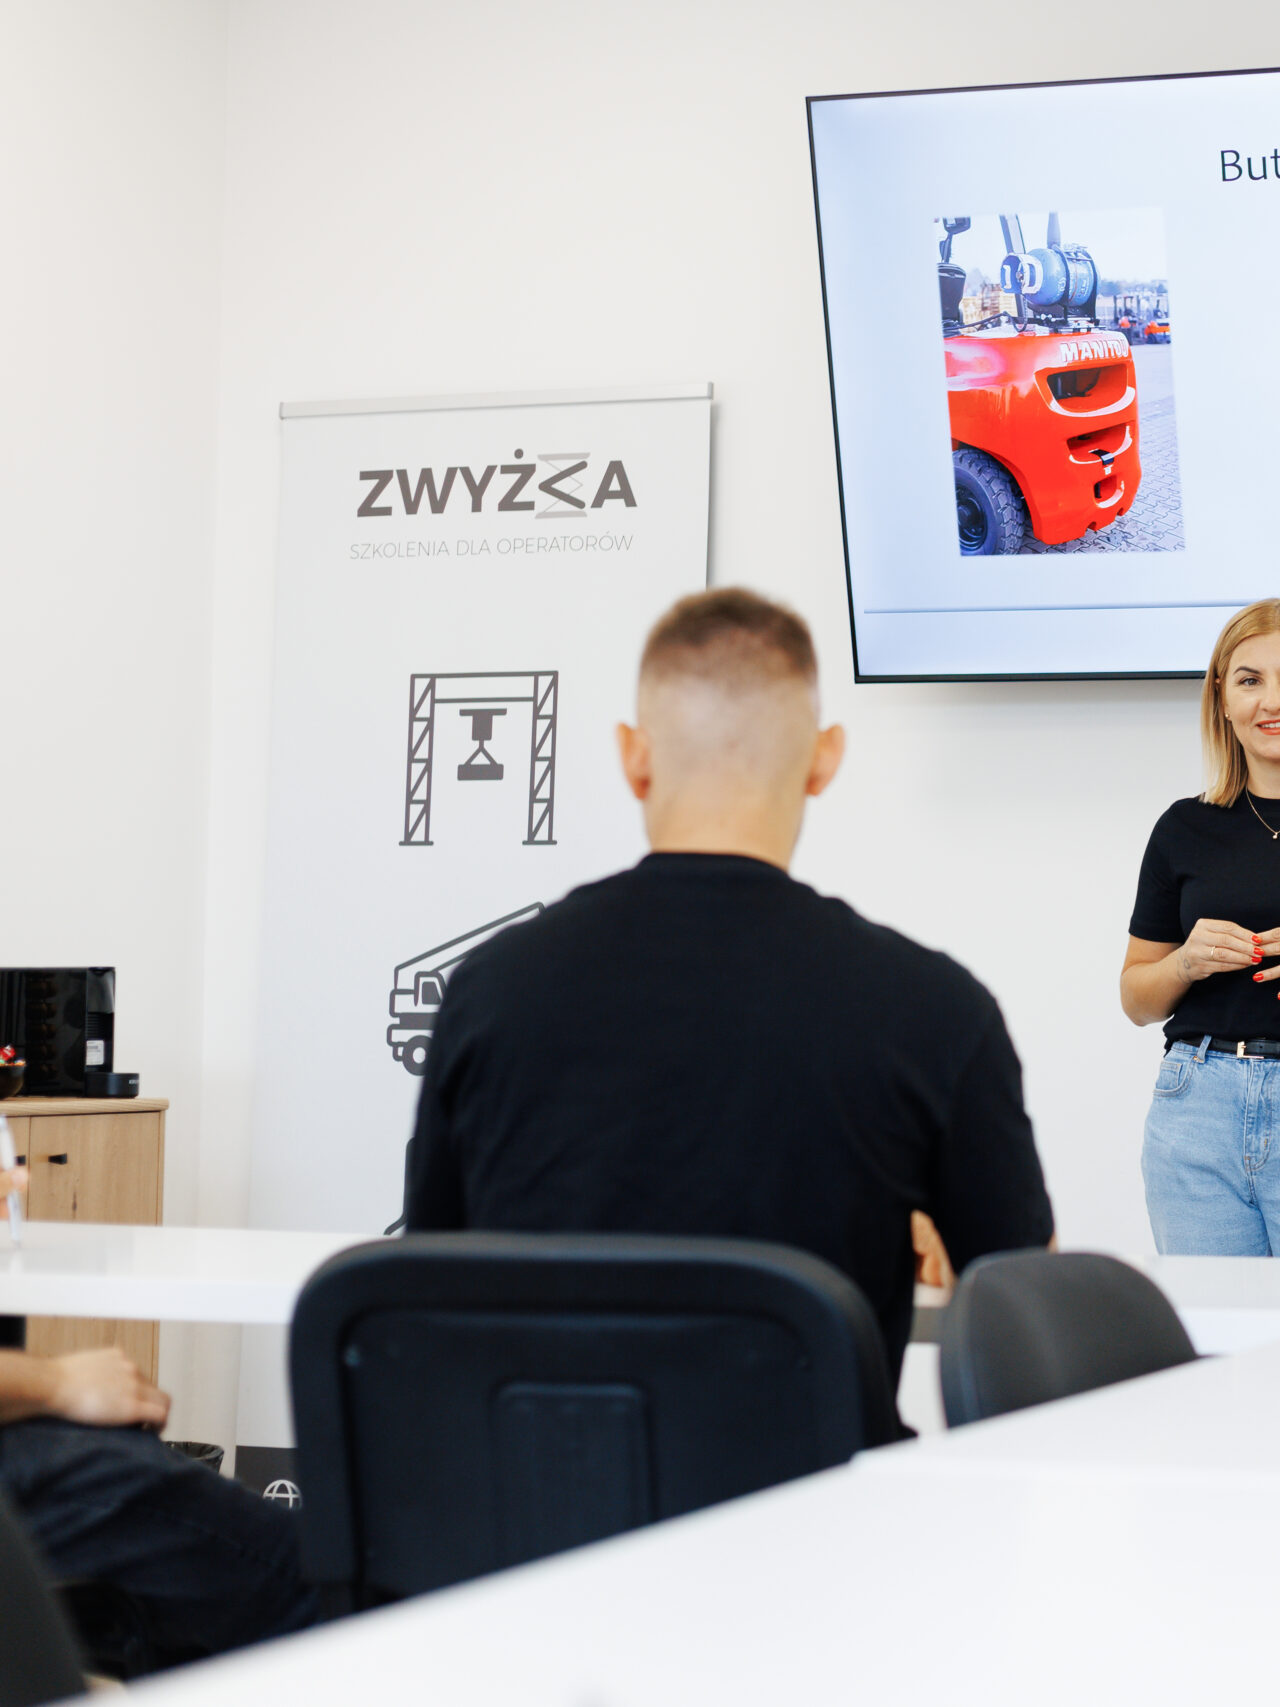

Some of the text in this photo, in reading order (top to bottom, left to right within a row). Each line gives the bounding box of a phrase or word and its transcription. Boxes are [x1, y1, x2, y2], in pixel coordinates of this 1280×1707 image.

[1060, 339, 1130, 363] MANITOU
[350, 531, 634, 560] SZKOLENIA DLA OPERATORÓW
